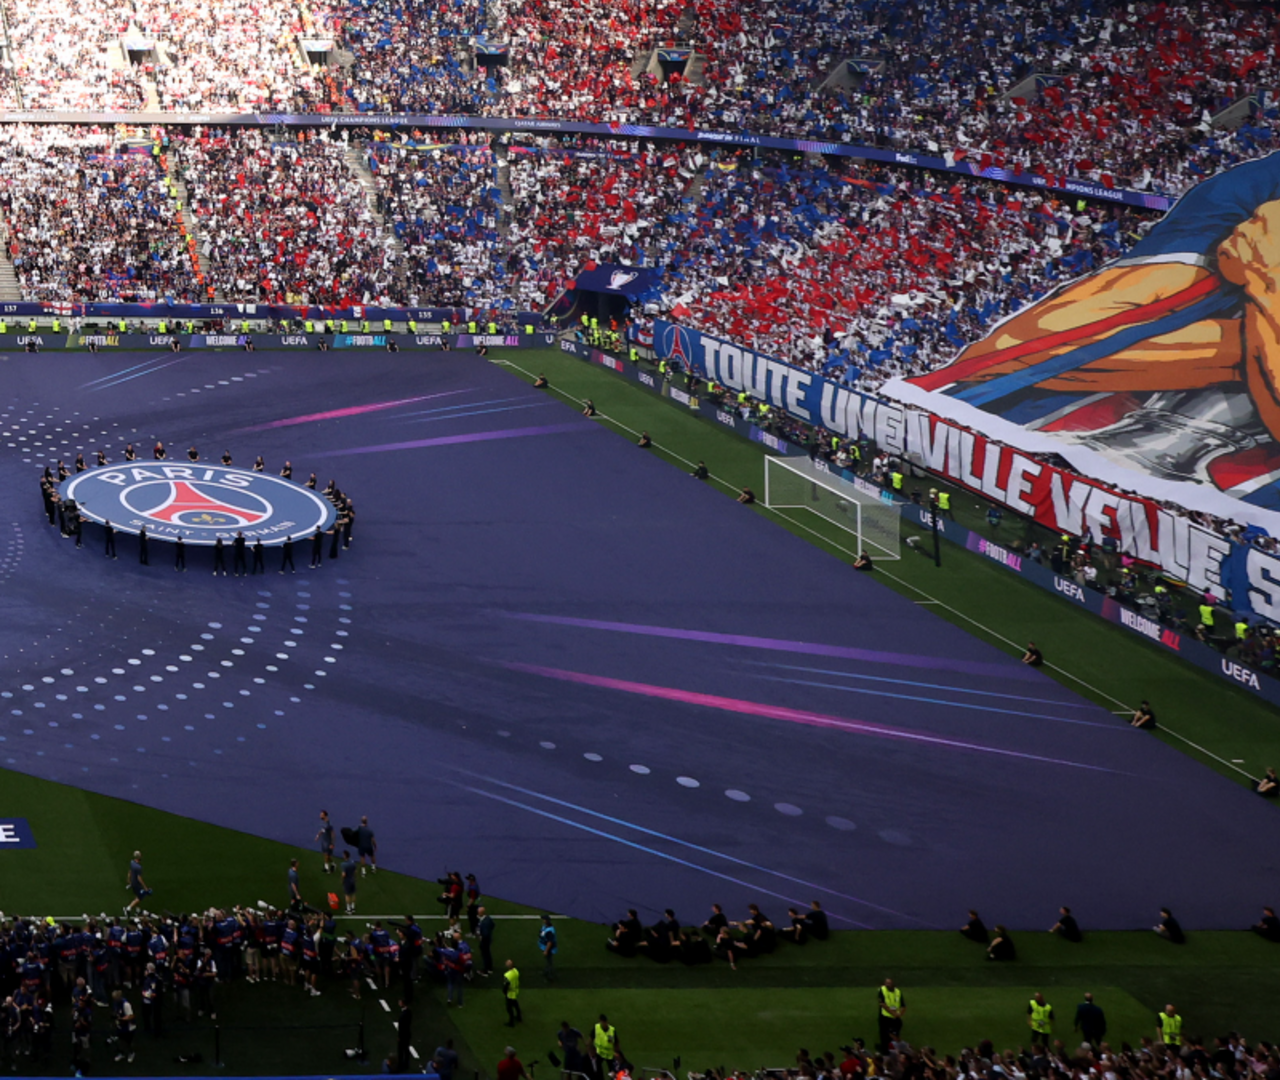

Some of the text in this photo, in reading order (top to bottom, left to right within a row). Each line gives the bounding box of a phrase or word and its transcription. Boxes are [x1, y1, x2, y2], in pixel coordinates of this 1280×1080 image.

[1094, 188, 1123, 201] LEAGUE
[4, 305, 17, 313] 137
[210, 307, 223, 315] 136
[418, 311, 432, 319] 135
[281, 336, 308, 345] UEFA
[416, 336, 442, 345] UEFA
[505, 335, 519, 346] ALL
[701, 334, 812, 420] TOUTE
[820, 381, 905, 456] UNE
[909, 407, 1042, 516] VILLE
[97, 466, 254, 487] PARIS
[977, 537, 1022, 572] #FOOTBALL
[1054, 575, 1085, 603] UEFA
[1120, 607, 1181, 651] WELCOME ALL
[1221, 658, 1260, 691] UEFA
